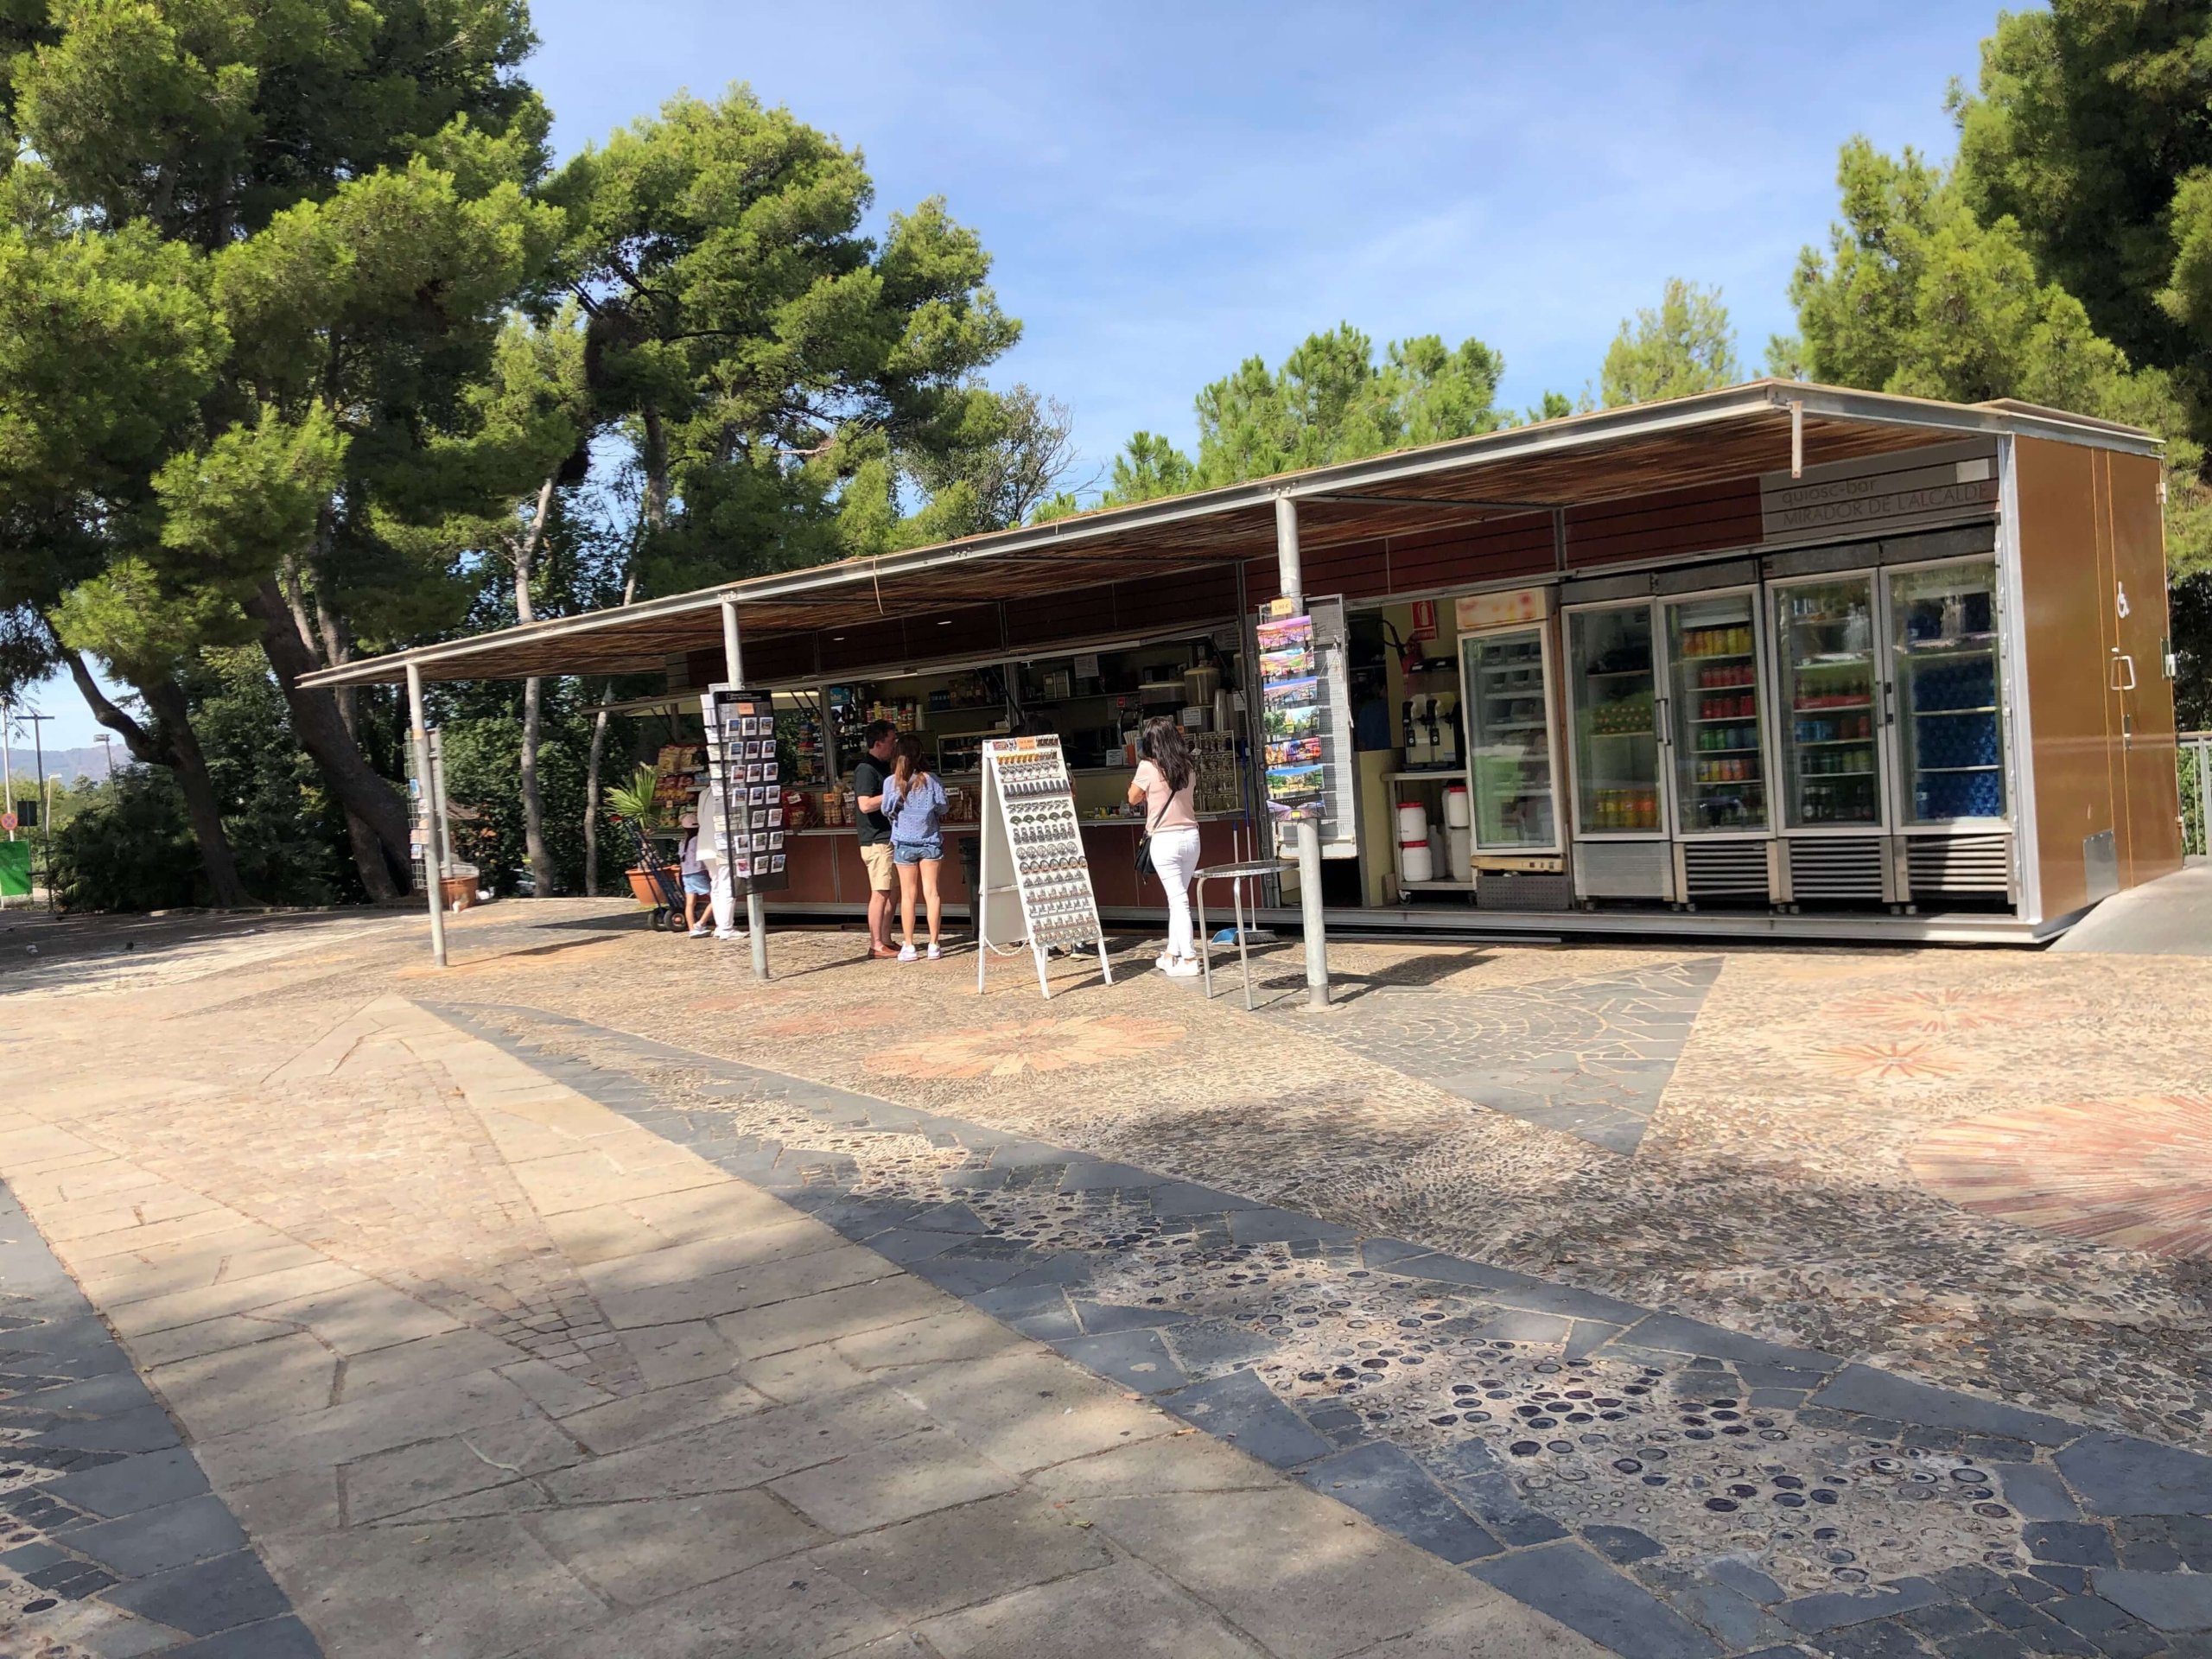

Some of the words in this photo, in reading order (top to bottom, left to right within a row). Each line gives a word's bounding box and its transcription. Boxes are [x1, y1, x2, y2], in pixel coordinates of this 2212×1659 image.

[1782, 479, 1877, 505] quiosc-bar
[1783, 501, 1863, 526] MIRADOR
[1869, 499, 1891, 514] DE
[1897, 484, 1986, 511] L'ALCALDE
